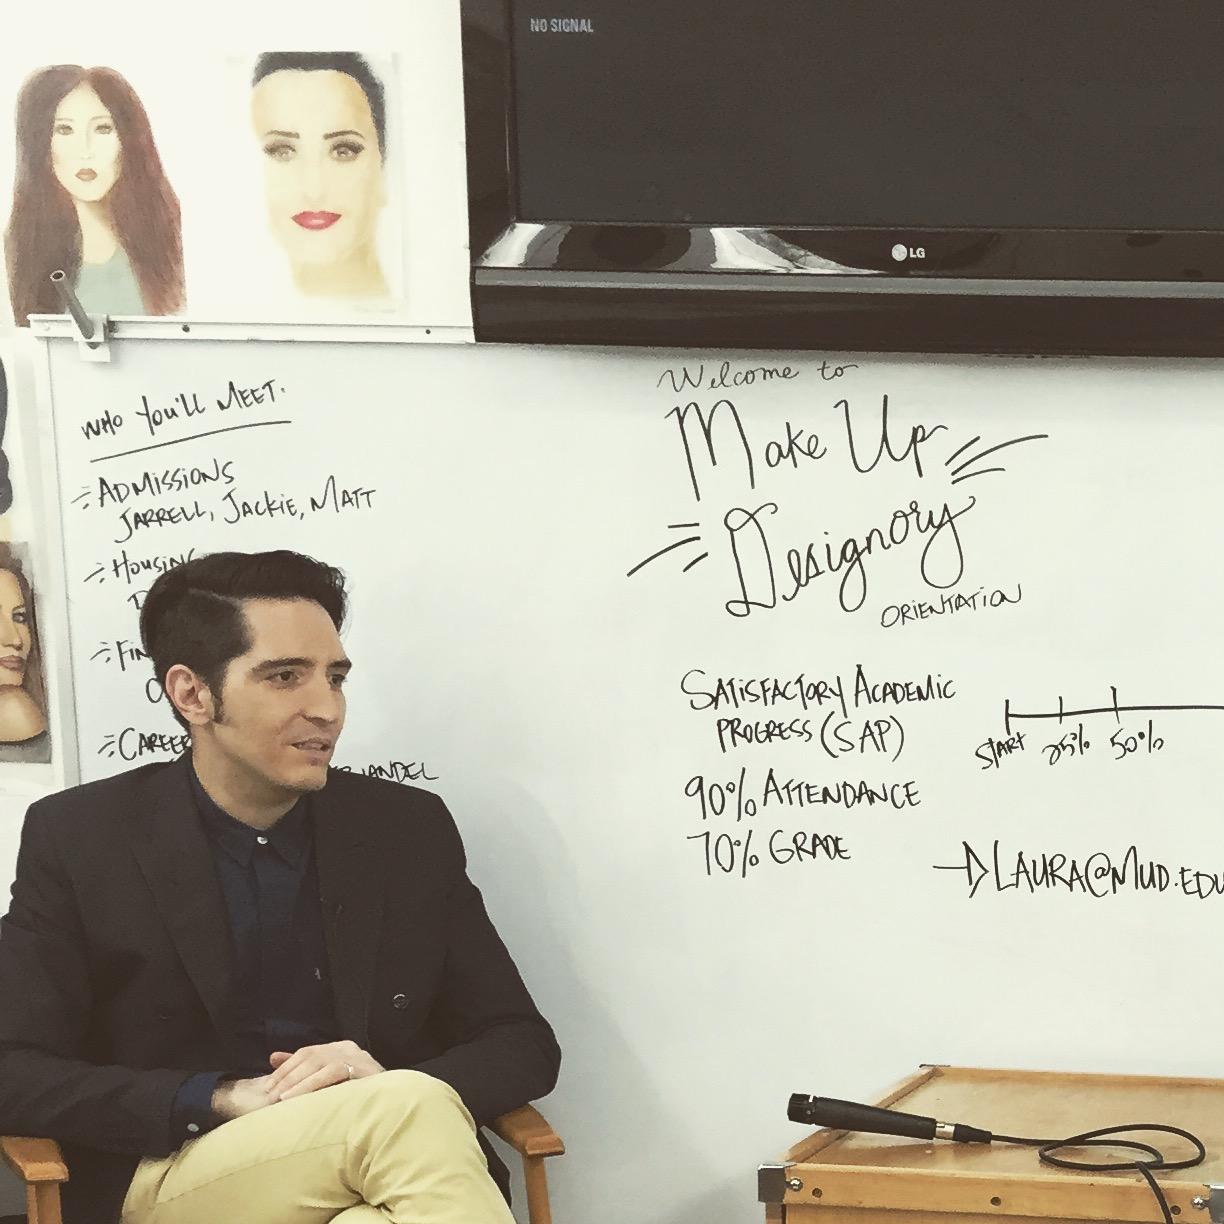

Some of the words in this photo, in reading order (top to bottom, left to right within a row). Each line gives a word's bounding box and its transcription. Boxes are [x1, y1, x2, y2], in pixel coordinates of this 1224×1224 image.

[530, 18, 548, 33] NO
[550, 18, 594, 33] SIGNAL
[909, 247, 926, 258] LG
[656, 360, 800, 393] Welcome
[817, 361, 860, 382] to
[663, 398, 828, 502] Make
[833, 393, 949, 478] Up
[310, 474, 377, 513] MATT
[723, 495, 977, 618] Designory
[1108, 720, 1165, 760] 50%
[684, 767, 758, 822] 90%
[762, 768, 921, 809] ATTENDANCE
[686, 830, 760, 879] 70%
[768, 832, 852, 864] GRADE
